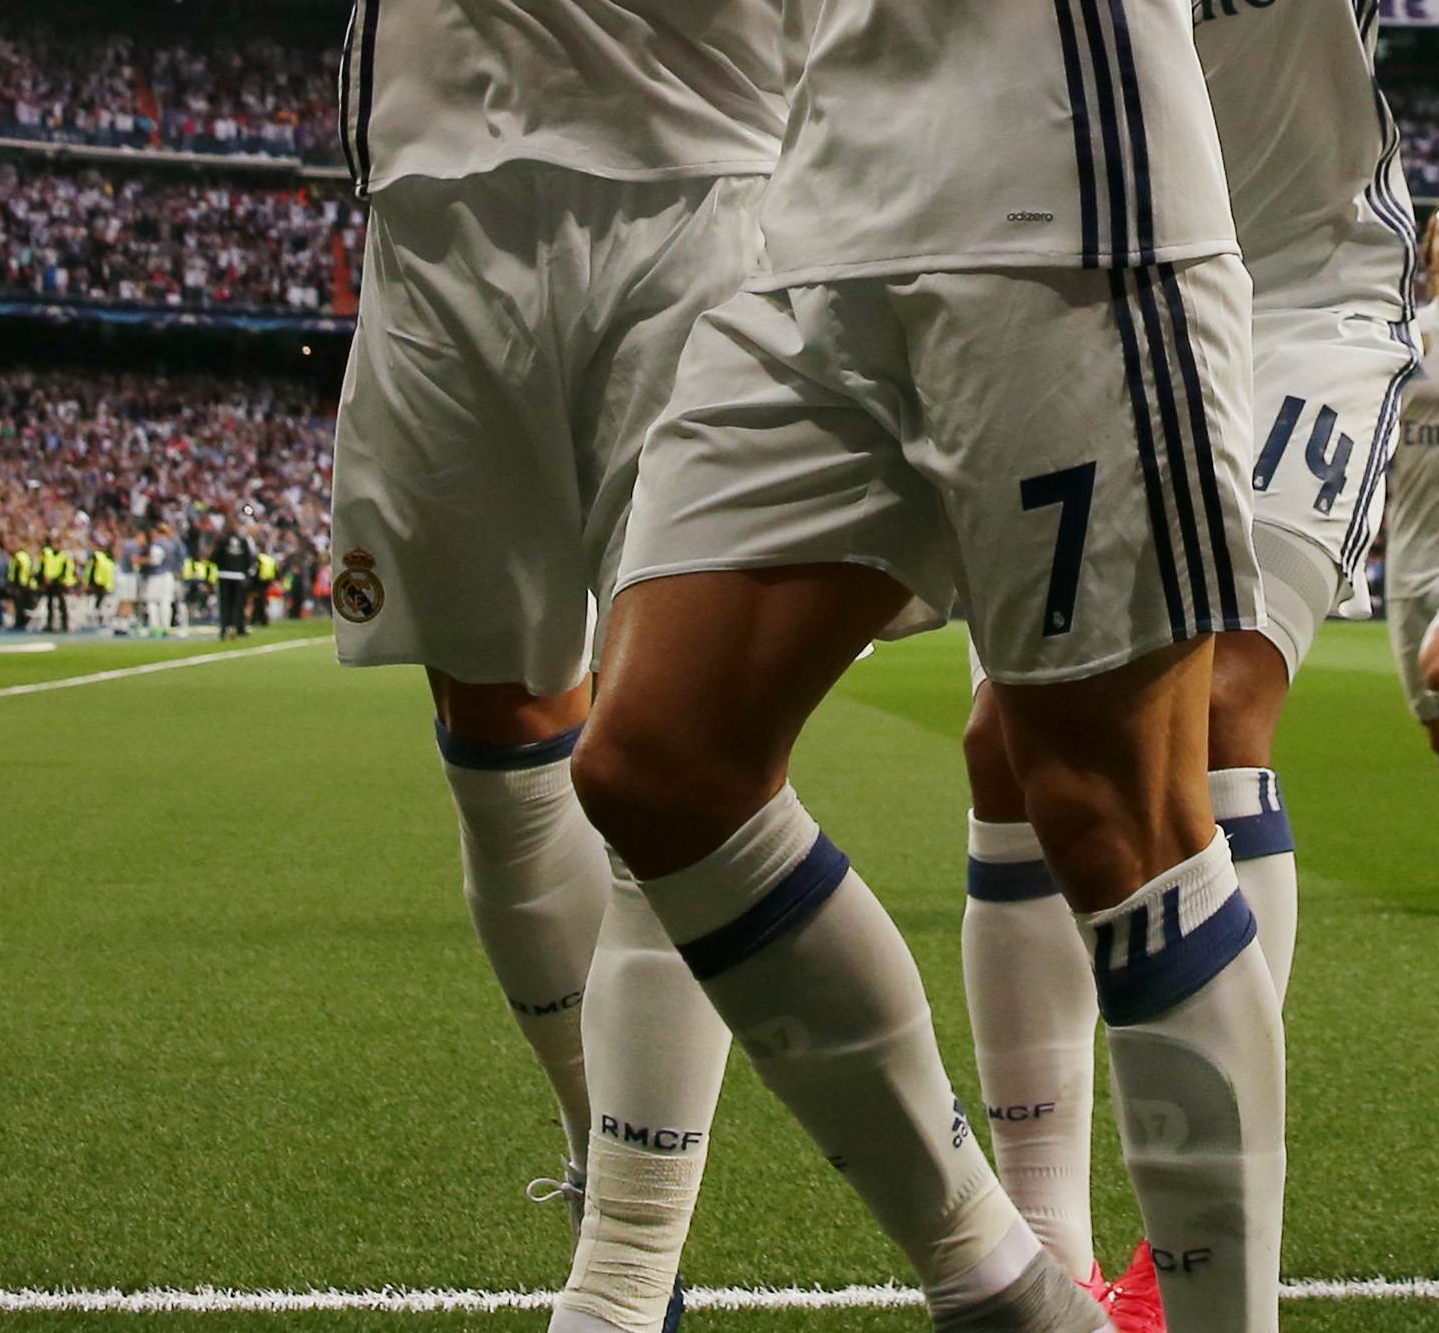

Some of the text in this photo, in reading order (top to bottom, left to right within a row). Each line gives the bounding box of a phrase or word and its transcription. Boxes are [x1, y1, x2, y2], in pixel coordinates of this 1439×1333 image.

[1006, 210, 1054, 223] adizero
[1252, 395, 1354, 516] 14
[1019, 460, 1097, 638] 7
[510, 991, 583, 1016] RMC
[986, 1102, 1055, 1122] MCF
[601, 1114, 703, 1151] RMCF
[1152, 1247, 1212, 1273] CF
